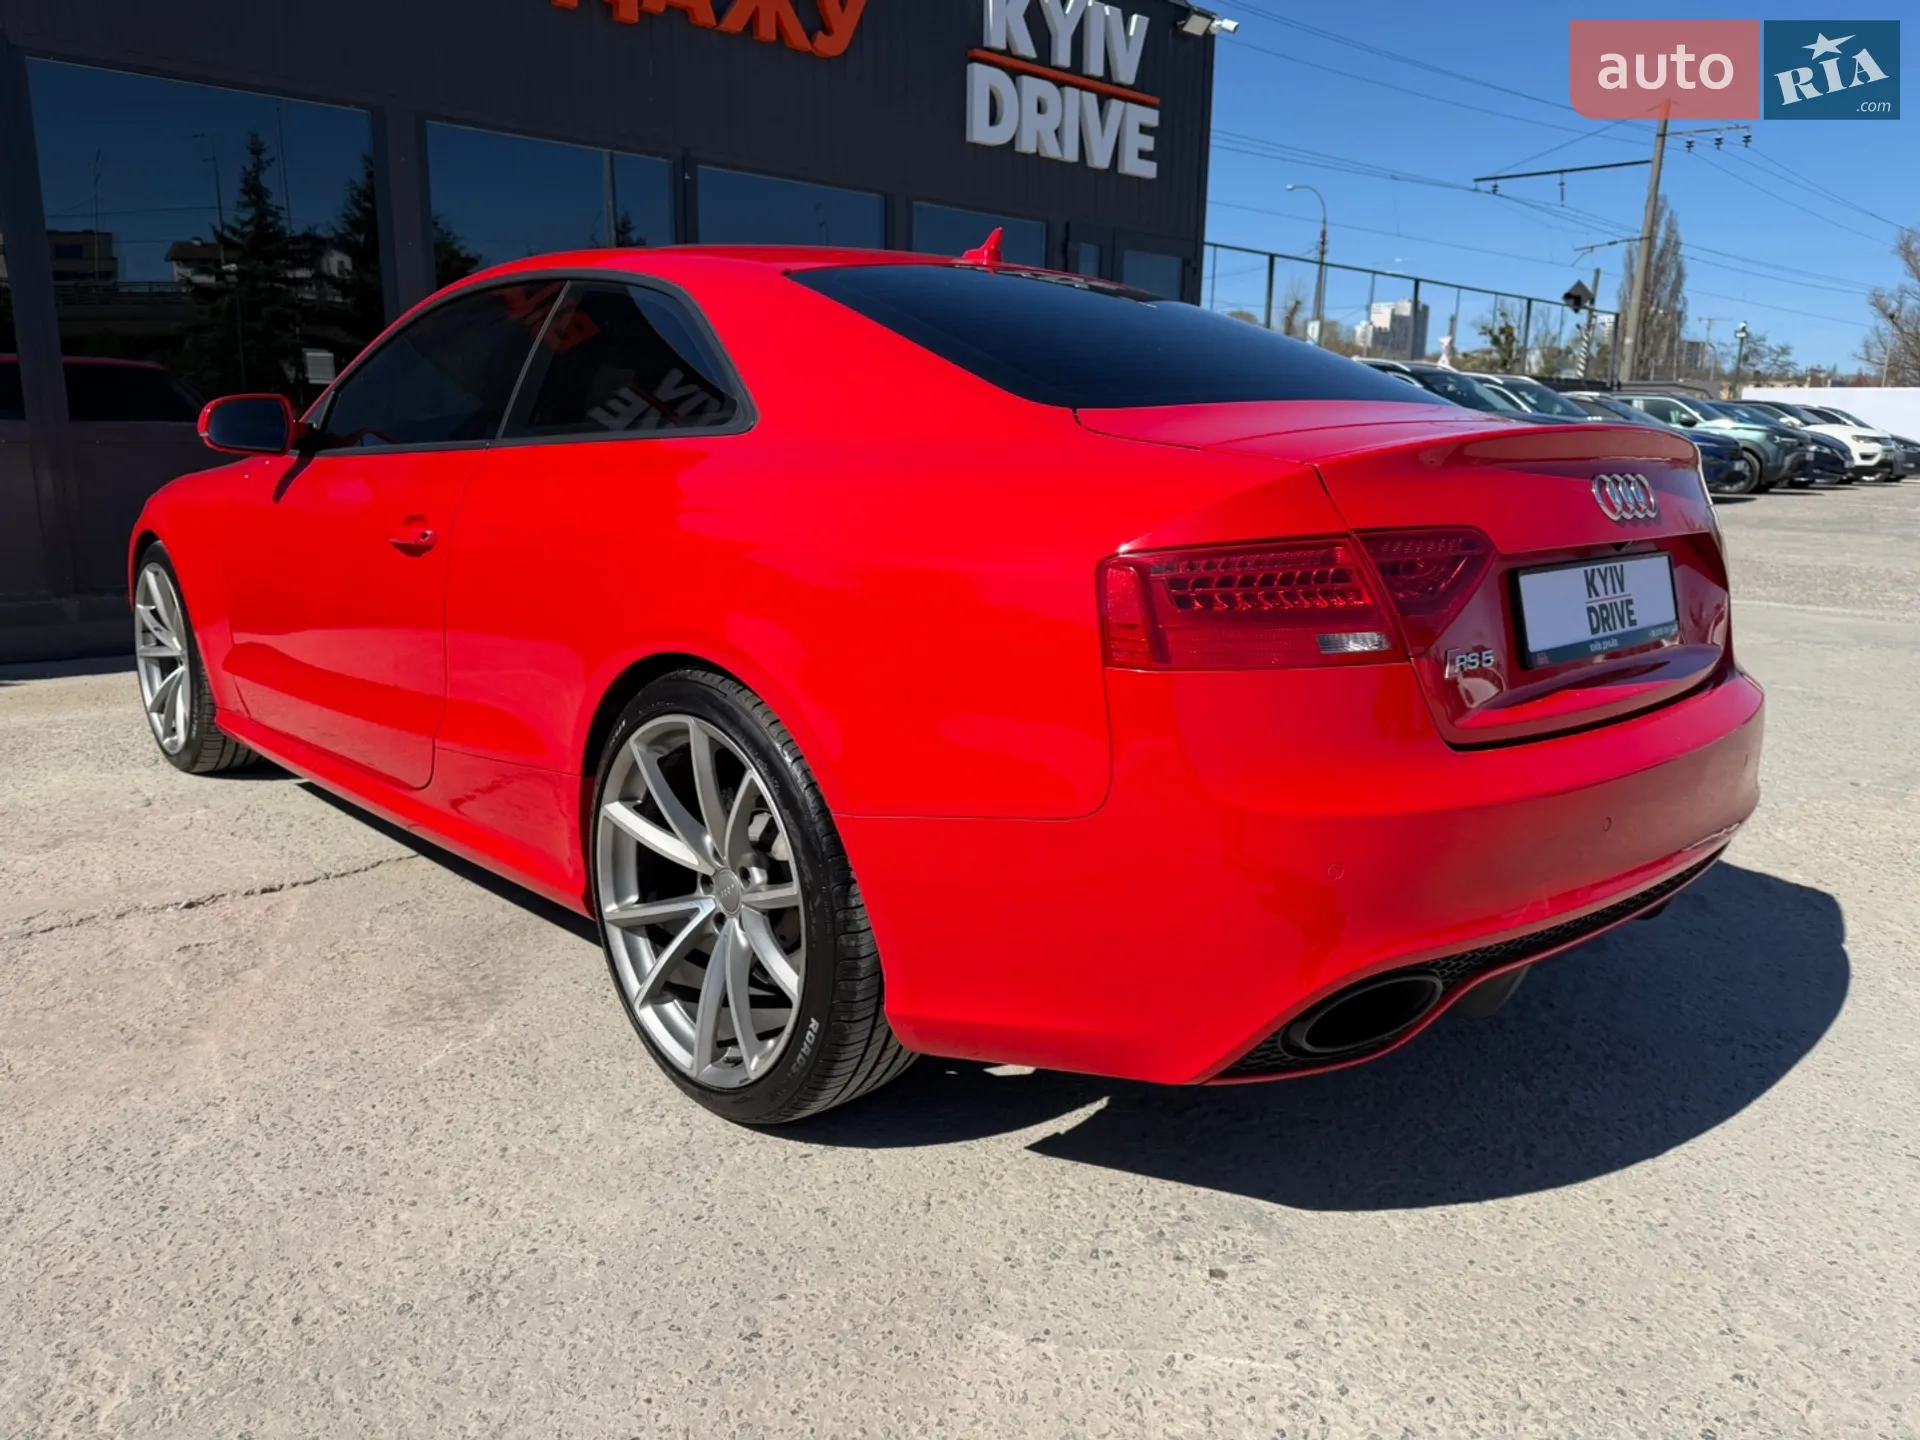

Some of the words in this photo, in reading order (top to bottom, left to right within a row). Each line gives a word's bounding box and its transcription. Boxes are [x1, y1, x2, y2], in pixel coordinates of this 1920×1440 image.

[983, 0, 1150, 85] KYIV
[966, 62, 1160, 179] DRIVE
[1583, 564, 1625, 599] KYIV
[1586, 598, 1638, 635] DRIVE
